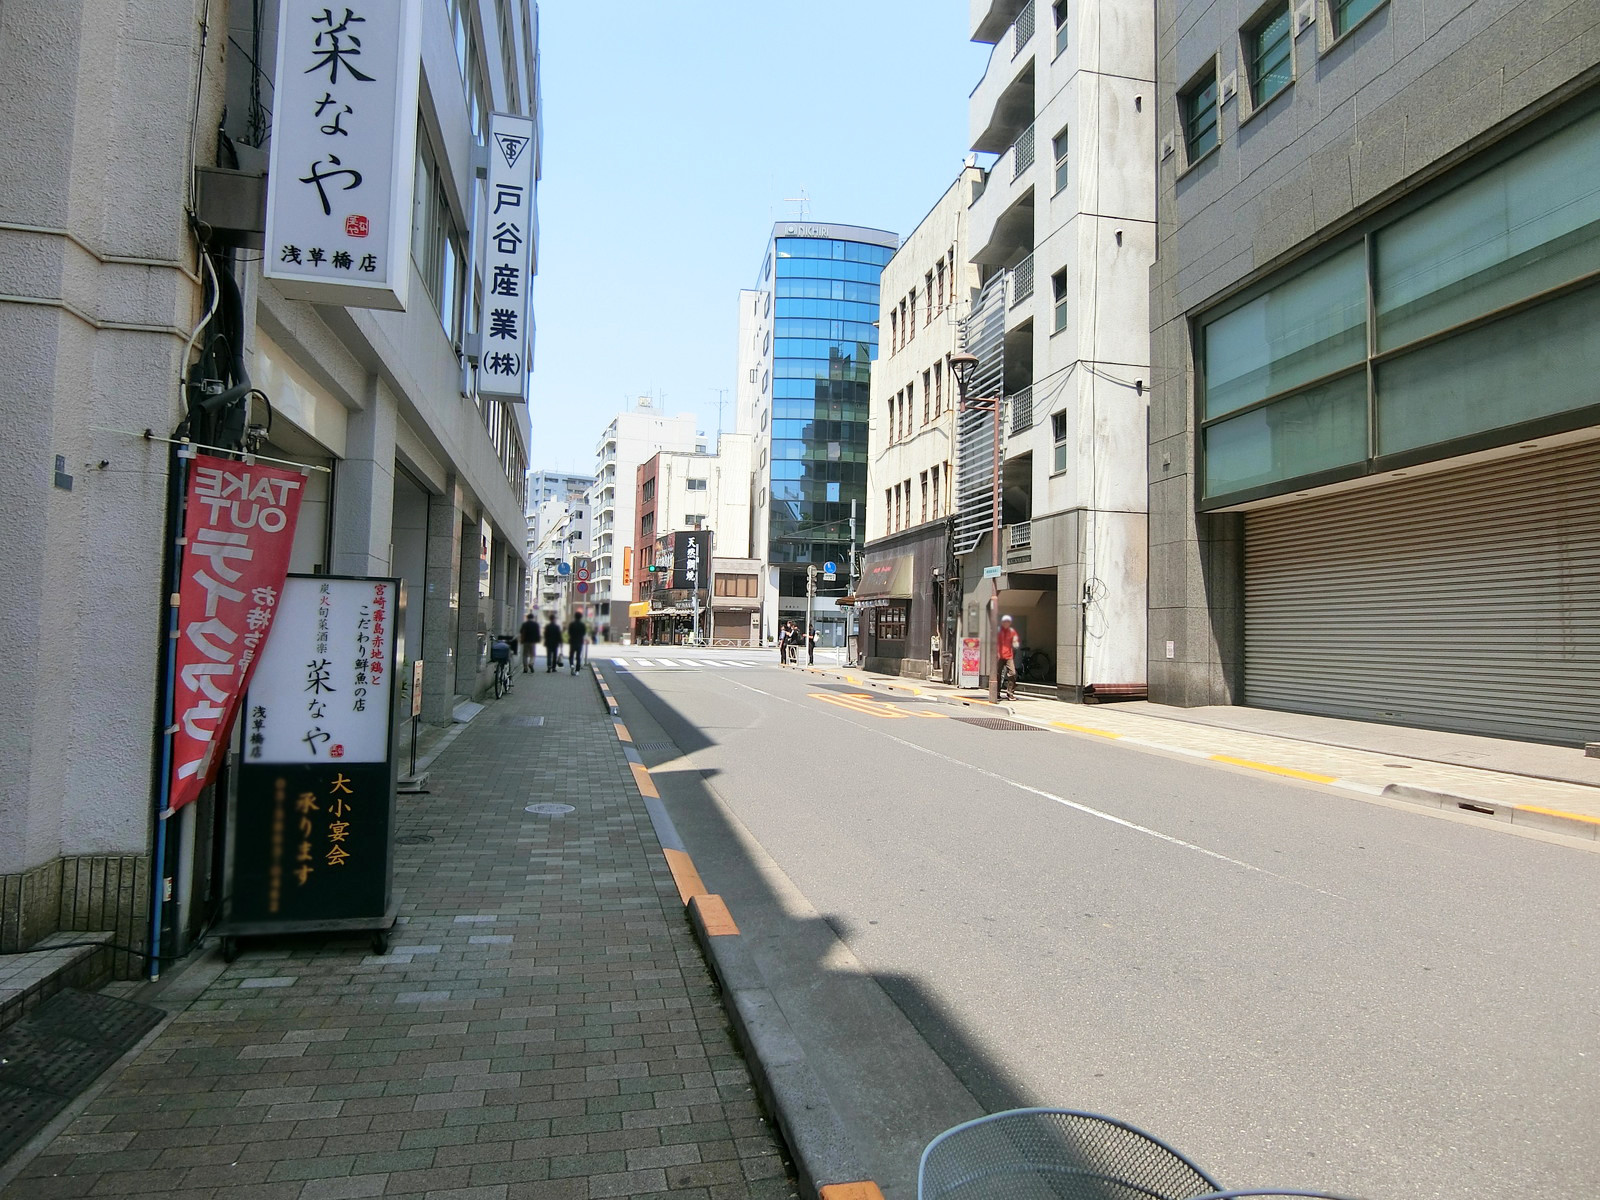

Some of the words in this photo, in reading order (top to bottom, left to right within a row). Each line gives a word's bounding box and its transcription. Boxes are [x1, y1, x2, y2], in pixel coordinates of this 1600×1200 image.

[299, 8, 377, 216] 菜なや
[280, 244, 378, 273] 浅草橋店
[483, 183, 524, 377] 戸谷産業(株)
[316, 583, 330, 654] 炭火旬菜酒楽
[353, 605, 371, 712] こだわり鮮魚の店
[370, 583, 387, 686] 宮崎霧島赤地鶏と
[250, 705, 267, 759] 浅草橋店
[302, 658, 337, 755] 菜なや
[325, 773, 354, 866] 大小宴会
